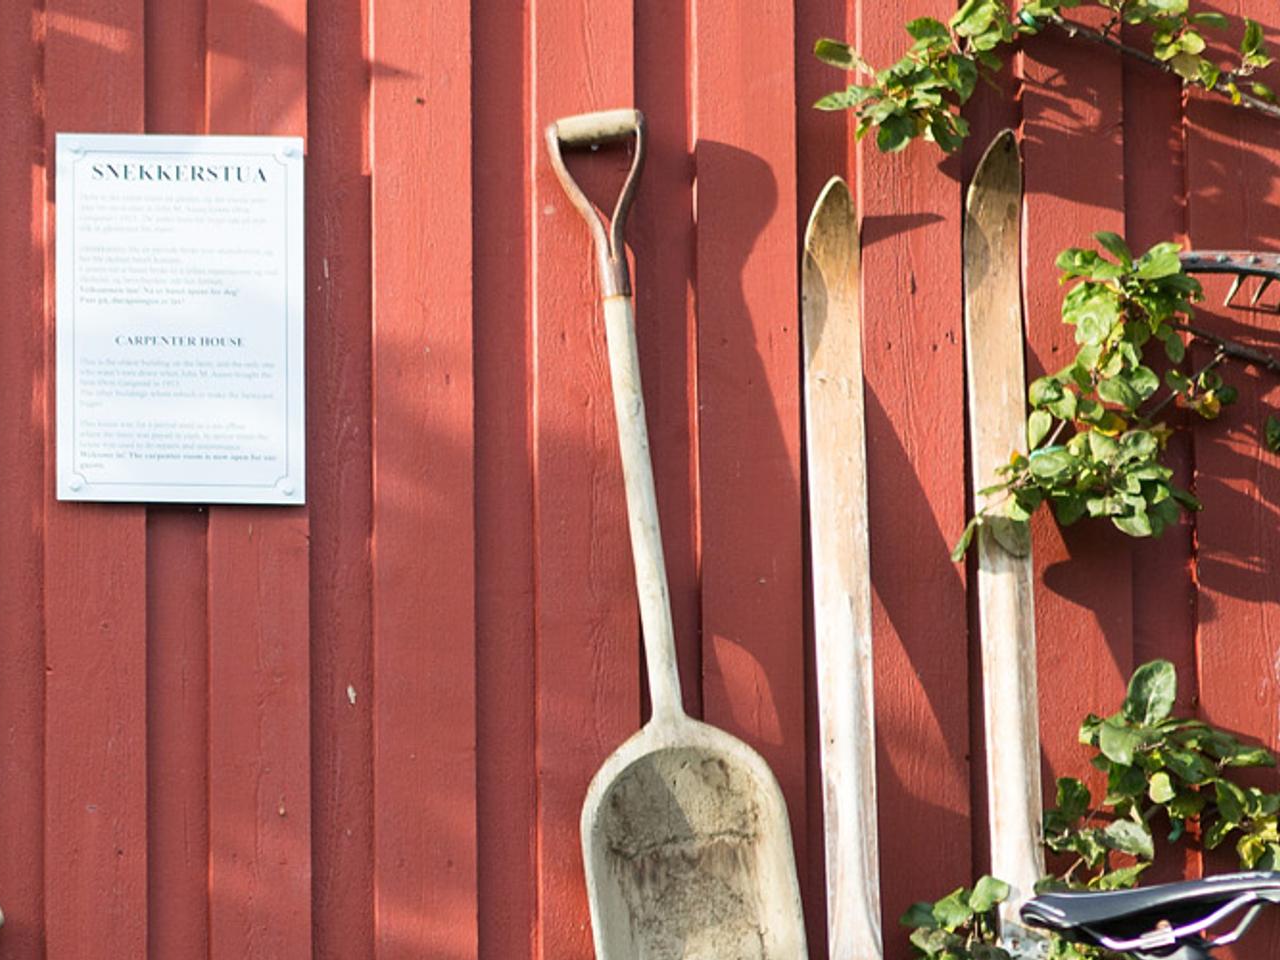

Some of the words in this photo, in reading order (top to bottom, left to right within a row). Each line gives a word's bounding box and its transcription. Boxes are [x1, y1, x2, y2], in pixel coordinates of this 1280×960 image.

[91, 164, 268, 183] SNEKKERSTUA
[115, 335, 197, 347] CARPENTER
[200, 337, 245, 348] HOUSE
